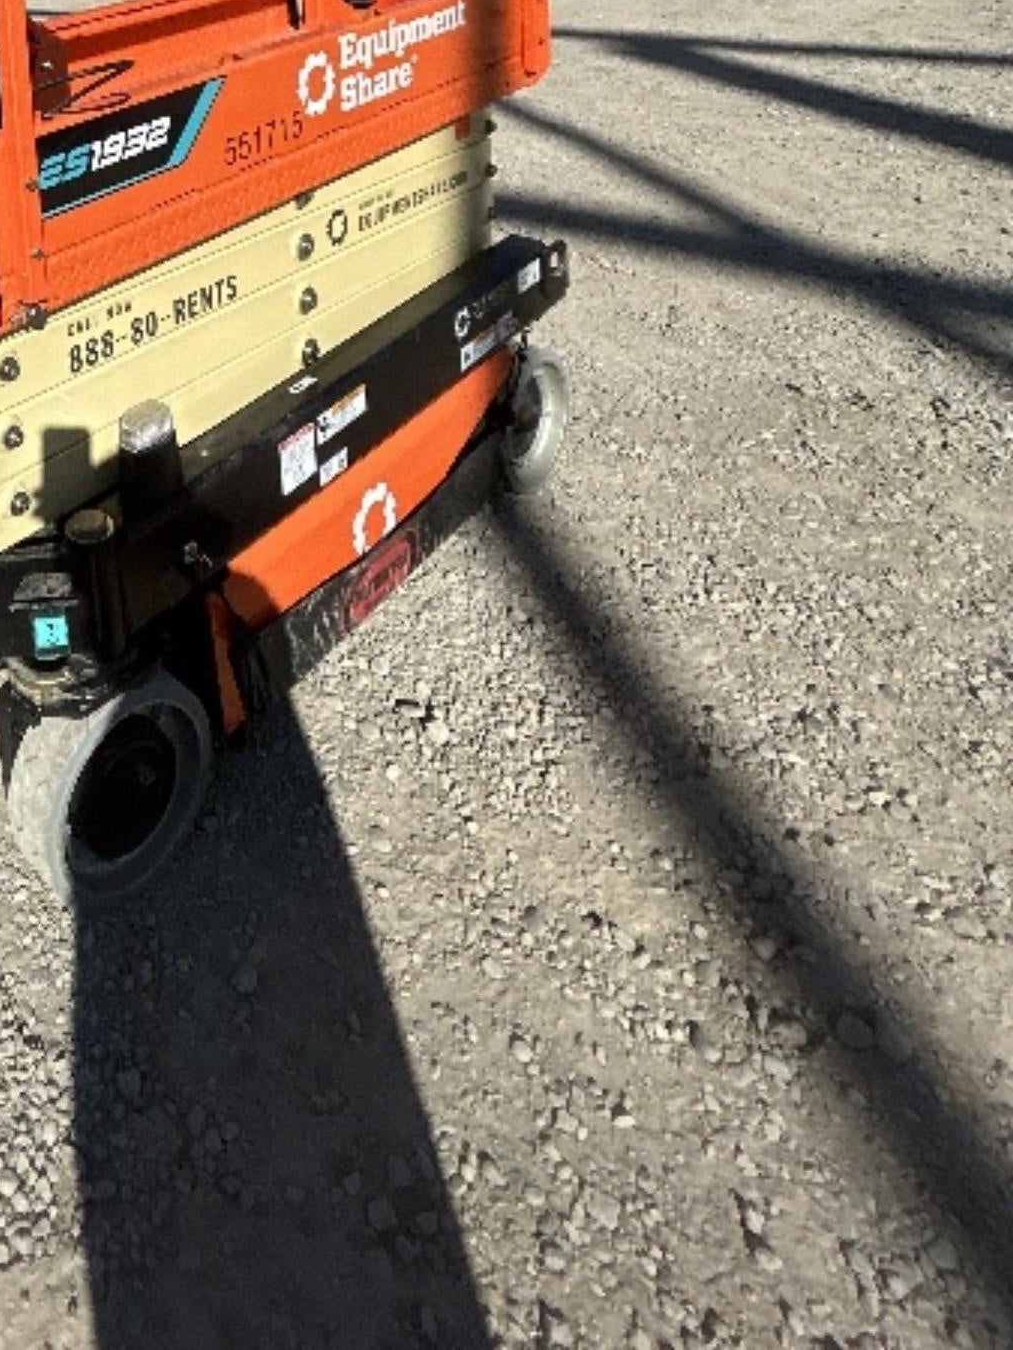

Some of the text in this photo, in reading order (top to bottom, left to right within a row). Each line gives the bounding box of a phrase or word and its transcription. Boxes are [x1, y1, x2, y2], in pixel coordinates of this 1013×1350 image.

[338, 0, 466, 69] Equipment
[340, 61, 416, 111] Share
[40, 115, 171, 190] ES1932
